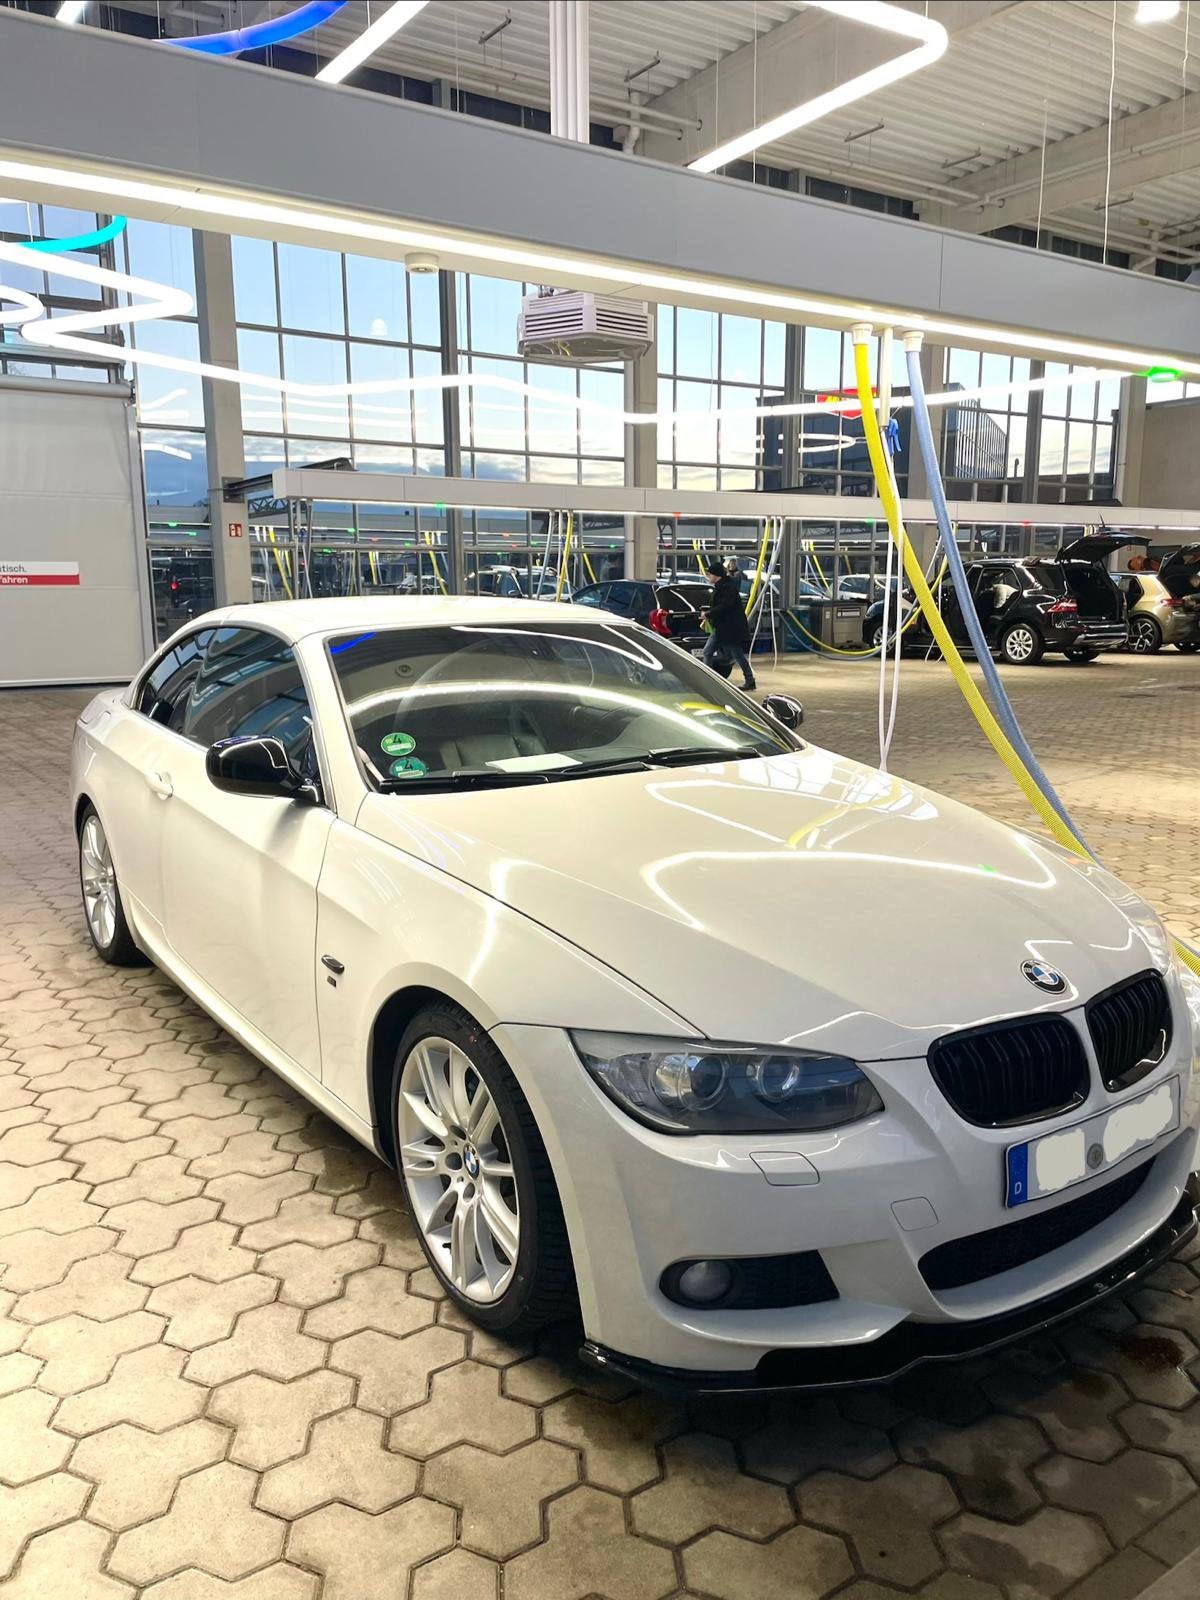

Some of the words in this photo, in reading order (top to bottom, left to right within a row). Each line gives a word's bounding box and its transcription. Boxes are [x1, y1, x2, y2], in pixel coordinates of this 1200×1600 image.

[0, 564, 27, 572] tisch.
[393, 735, 402, 744] 4
[1014, 1181, 1022, 1195] D
